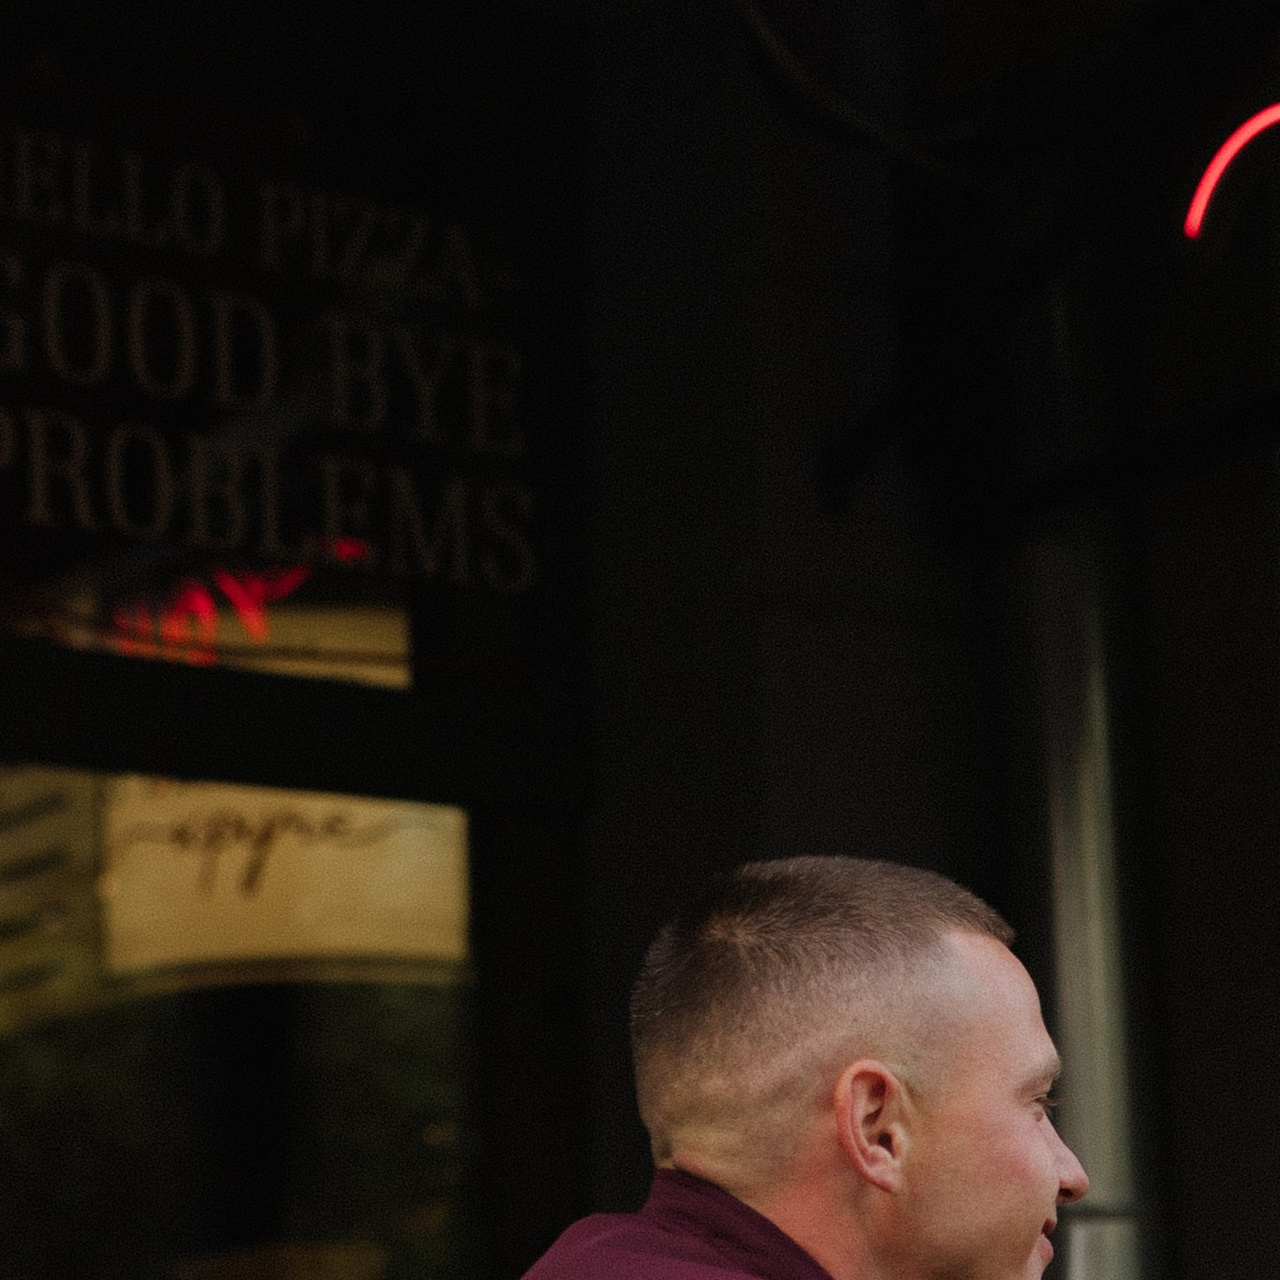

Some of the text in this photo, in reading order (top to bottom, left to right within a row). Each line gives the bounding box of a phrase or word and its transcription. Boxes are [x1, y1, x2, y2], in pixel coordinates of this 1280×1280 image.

[0, 128, 226, 257] ELLO
[321, 310, 525, 457] BYE
[0, 402, 538, 595] ROBLEMS
